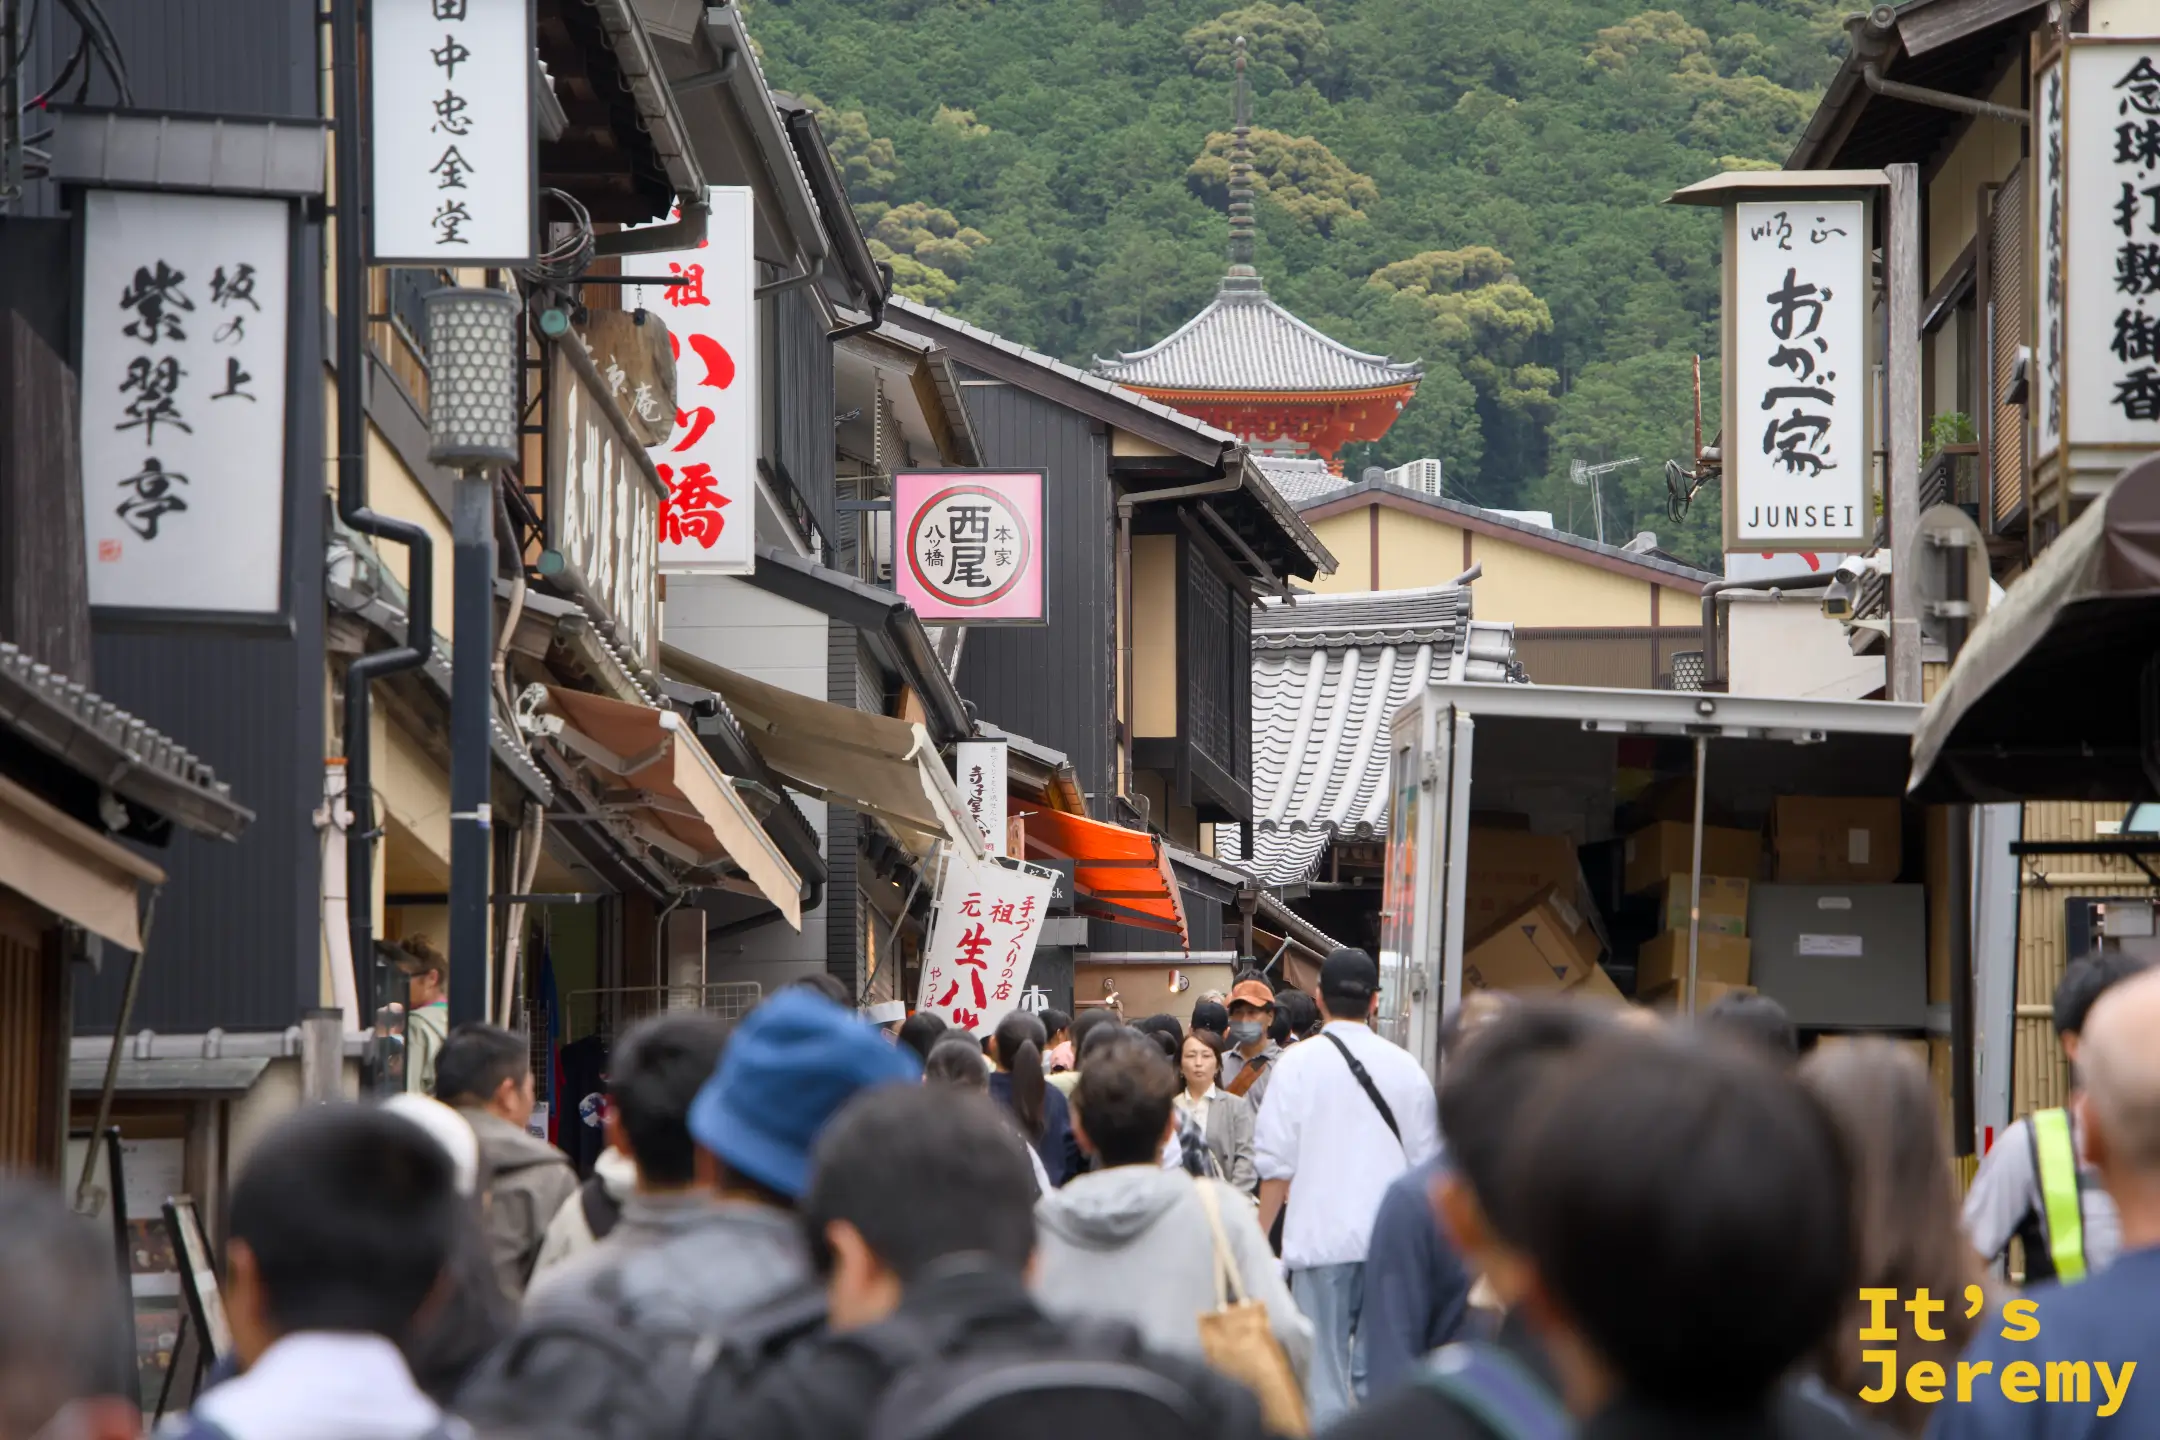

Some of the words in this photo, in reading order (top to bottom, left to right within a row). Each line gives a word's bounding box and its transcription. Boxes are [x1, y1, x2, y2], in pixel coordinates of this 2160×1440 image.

[209, 262, 262, 402] 坂の上
[656, 207, 735, 550] 祖八ツ橋
[924, 524, 946, 567] 八ツ橋
[942, 505, 992, 588] 西尾
[993, 525, 1014, 567] 本家
[1748, 505, 1855, 528] JUNSEI
[991, 895, 1036, 1000] 手づくりの店
